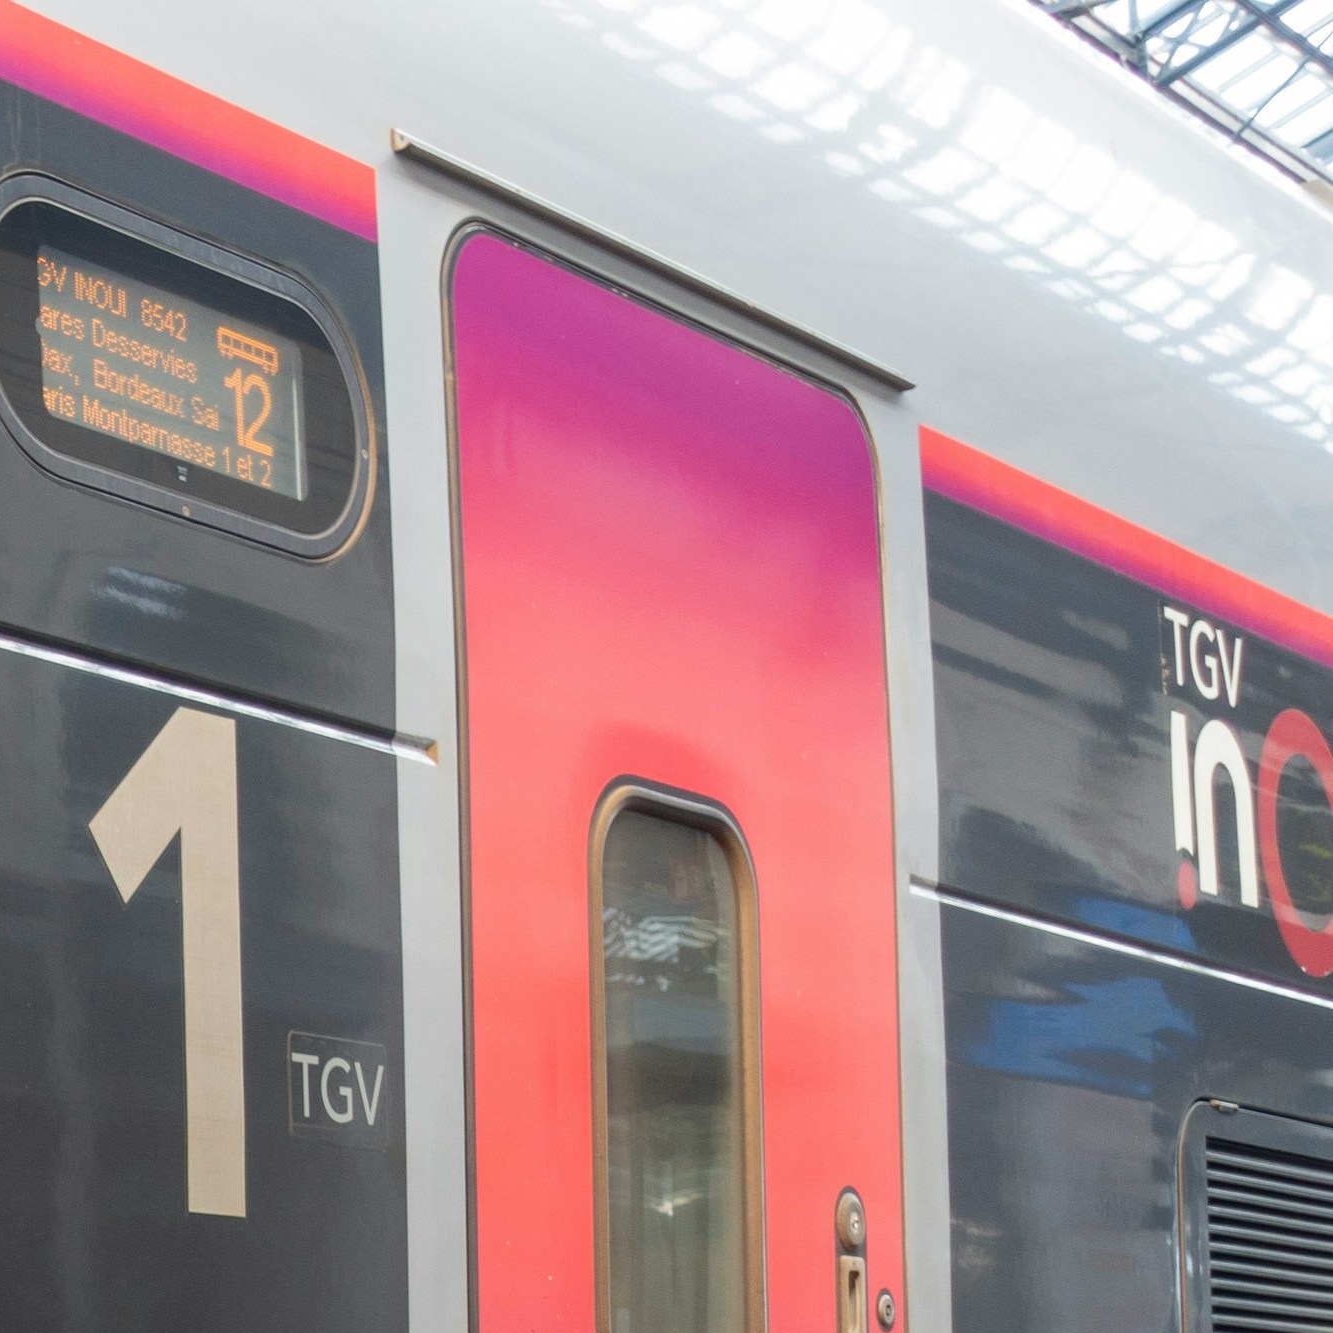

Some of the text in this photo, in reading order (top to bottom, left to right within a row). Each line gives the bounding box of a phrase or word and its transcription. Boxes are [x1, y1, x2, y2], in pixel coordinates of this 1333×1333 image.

[74, 271, 127, 318] INOUI
[140, 298, 188, 342] 8542
[91, 318, 197, 384] Desservies
[92, 358, 185, 420] Bordeaux
[191, 394, 220, 432] Sai
[222, 367, 274, 457] 12
[82, 394, 216, 469] Montparnasse
[221, 446, 231, 475] 1
[236, 454, 255, 483] et
[259, 459, 272, 489] 2
[1163, 605, 1243, 708] TGV
[88, 706, 246, 1218] 1
[291, 1051, 385, 1126] TGV
